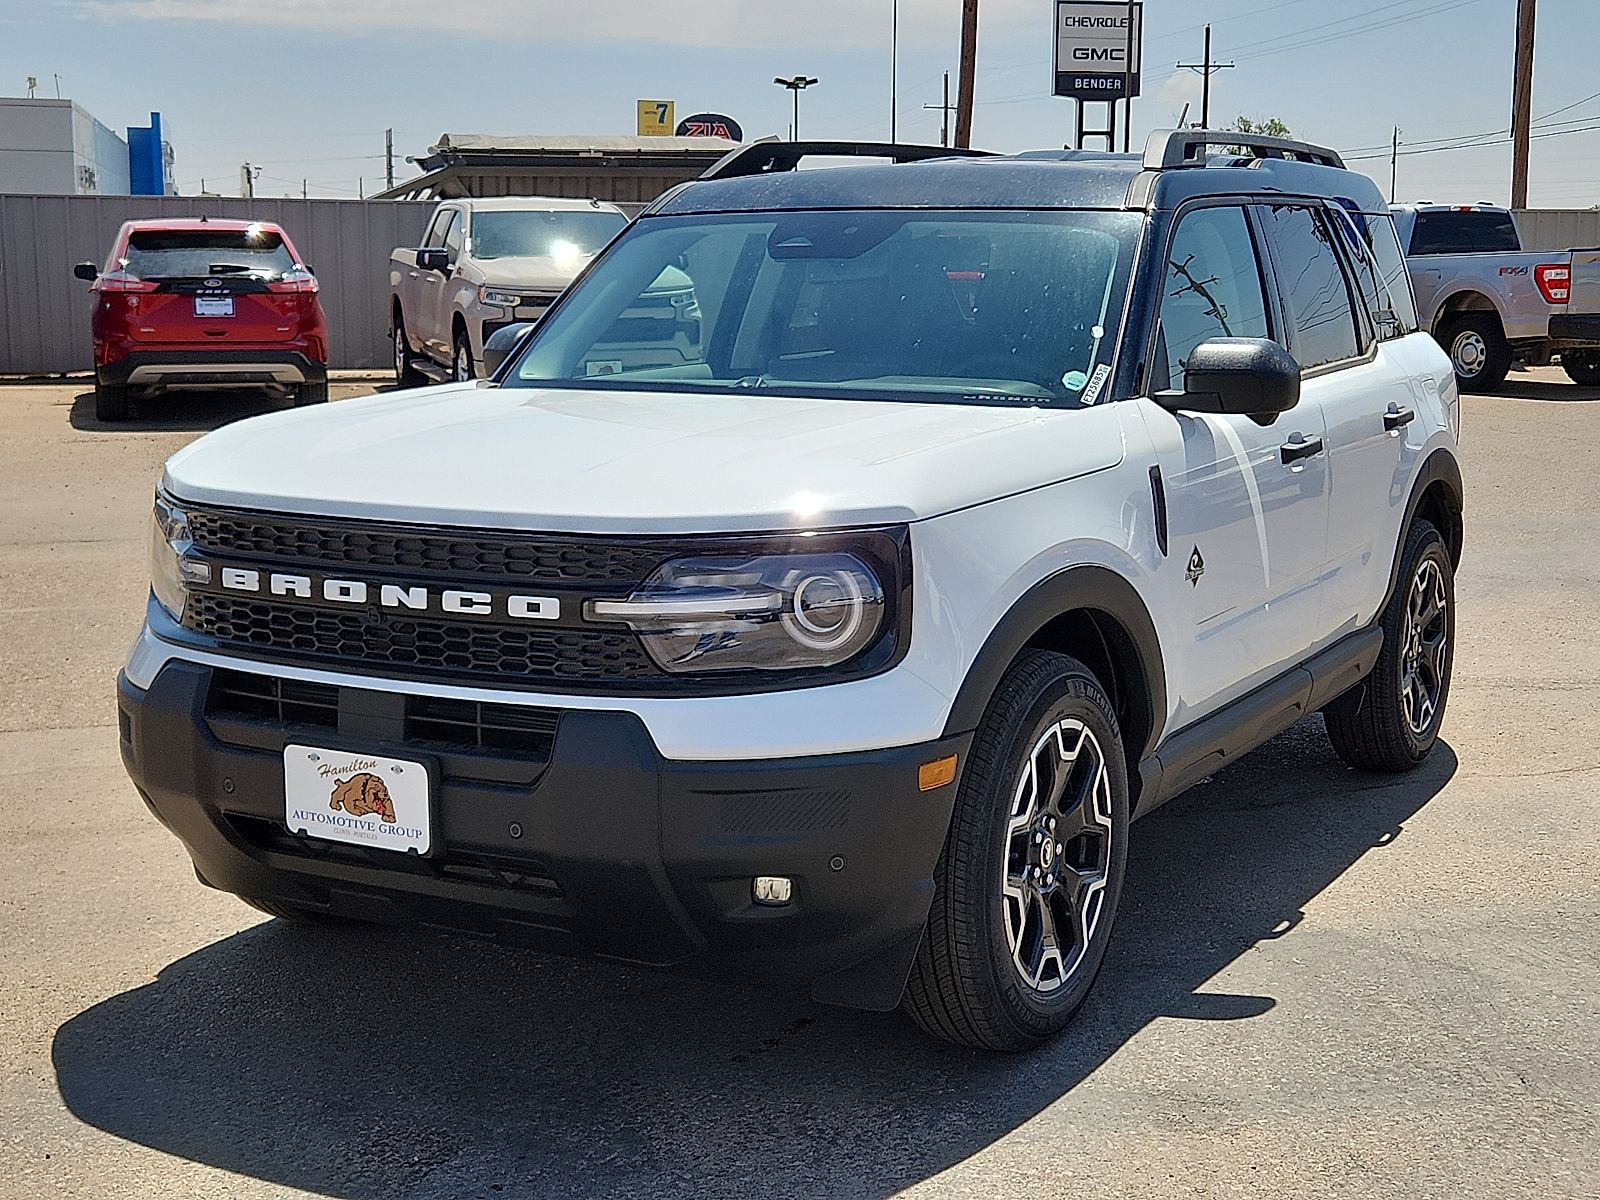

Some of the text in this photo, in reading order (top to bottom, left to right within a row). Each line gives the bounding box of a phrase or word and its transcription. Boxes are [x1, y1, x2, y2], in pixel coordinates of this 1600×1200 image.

[1065, 16, 1134, 28] CHEVROLE
[1073, 48, 1125, 60] GMC
[1075, 78, 1121, 89] BENDER
[656, 103, 668, 124] 7
[685, 122, 732, 140] ZIA
[222, 567, 560, 620] BRONCO
[317, 758, 378, 779] Hamilton
[292, 809, 423, 839] AUTOMOTIVE GROUP
